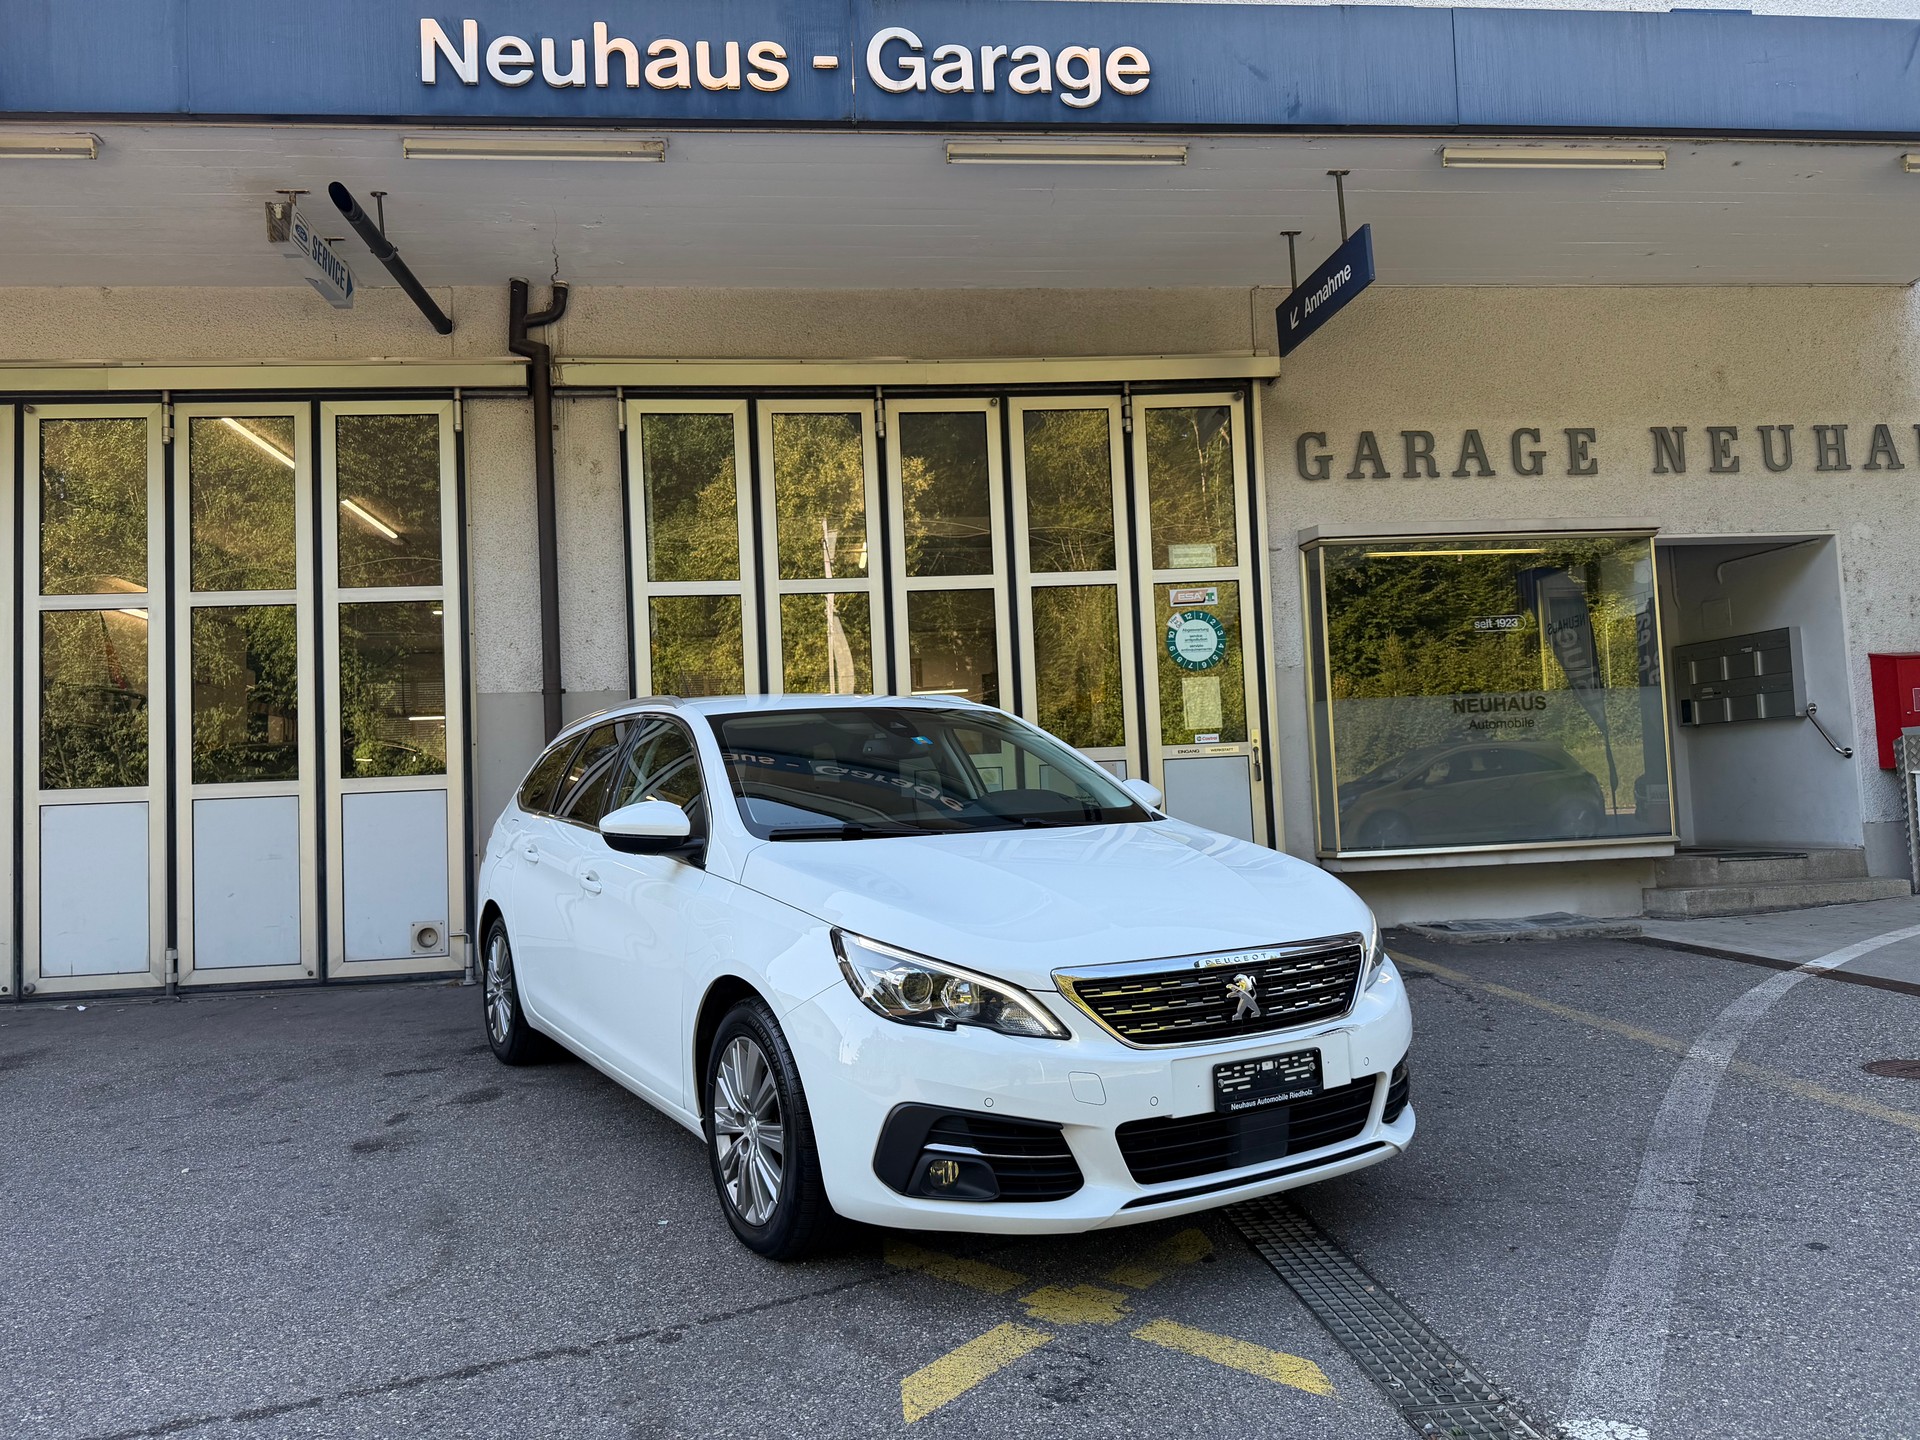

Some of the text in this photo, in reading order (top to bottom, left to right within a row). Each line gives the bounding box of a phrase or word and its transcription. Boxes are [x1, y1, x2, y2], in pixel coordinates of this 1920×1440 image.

[420, 18, 1151, 109] Neuhaus - Garage
[312, 234, 346, 292] SERVICE
[1304, 264, 1352, 318] Annahme
[1296, 423, 1920, 481] GARAGE NEUHA
[1177, 591, 1202, 601] ESA
[1184, 612, 1193, 620] 12
[1209, 618, 1217, 626] 2
[1474, 618, 1519, 629] seit 1923
[1168, 630, 1175, 639] 10
[1453, 696, 1547, 714] NEUHAUS
[1469, 717, 1535, 730] Automobile
[1205, 953, 1267, 965] PEUGEOT
[1231, 1088, 1313, 1111] Neuhaus Automobile Riedholz
